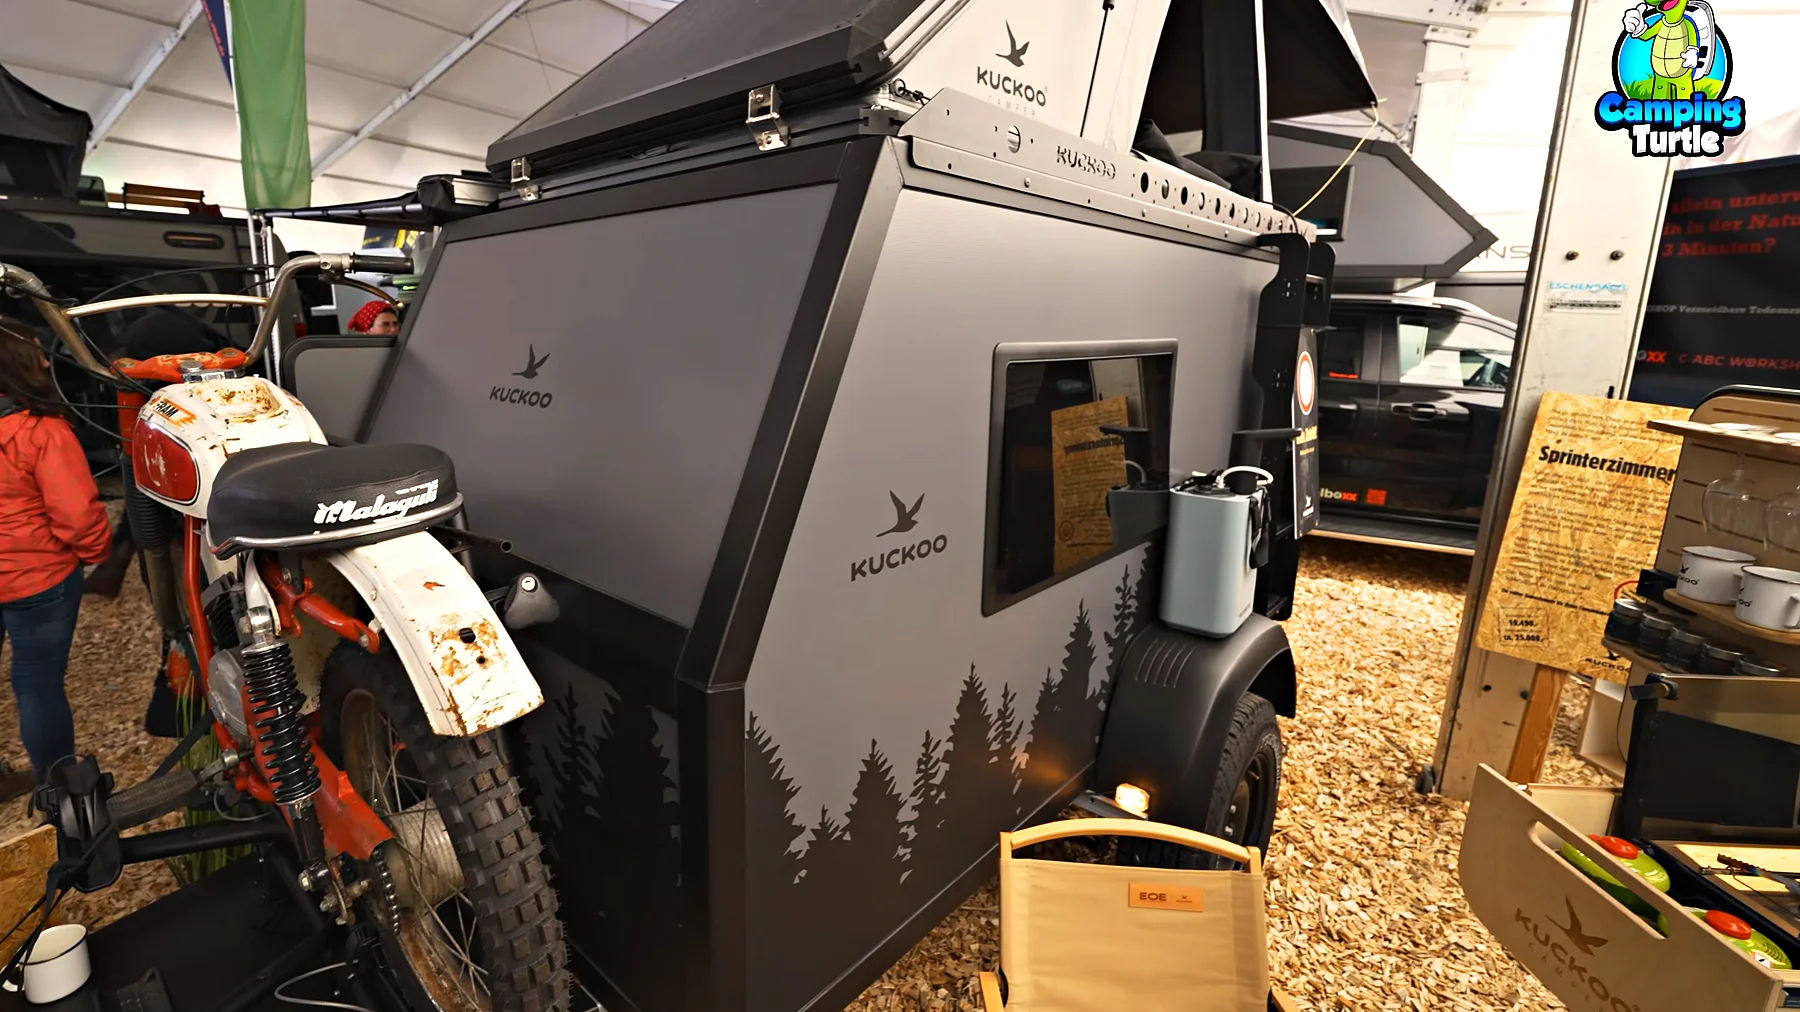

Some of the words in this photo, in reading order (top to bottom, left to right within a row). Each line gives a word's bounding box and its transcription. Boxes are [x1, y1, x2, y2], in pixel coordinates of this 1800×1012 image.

[977, 67, 1046, 107] KUCKOO
[1056, 145, 1116, 180] KUCKOO
[1709, 216, 1743, 233] der
[1677, 237, 1777, 257] Minuten?
[489, 386, 553, 409] KUCKOO
[1538, 445, 1677, 482] Sprinterzimmer
[850, 534, 948, 582] KUCKOO
[1139, 892, 1167, 901] EOE
